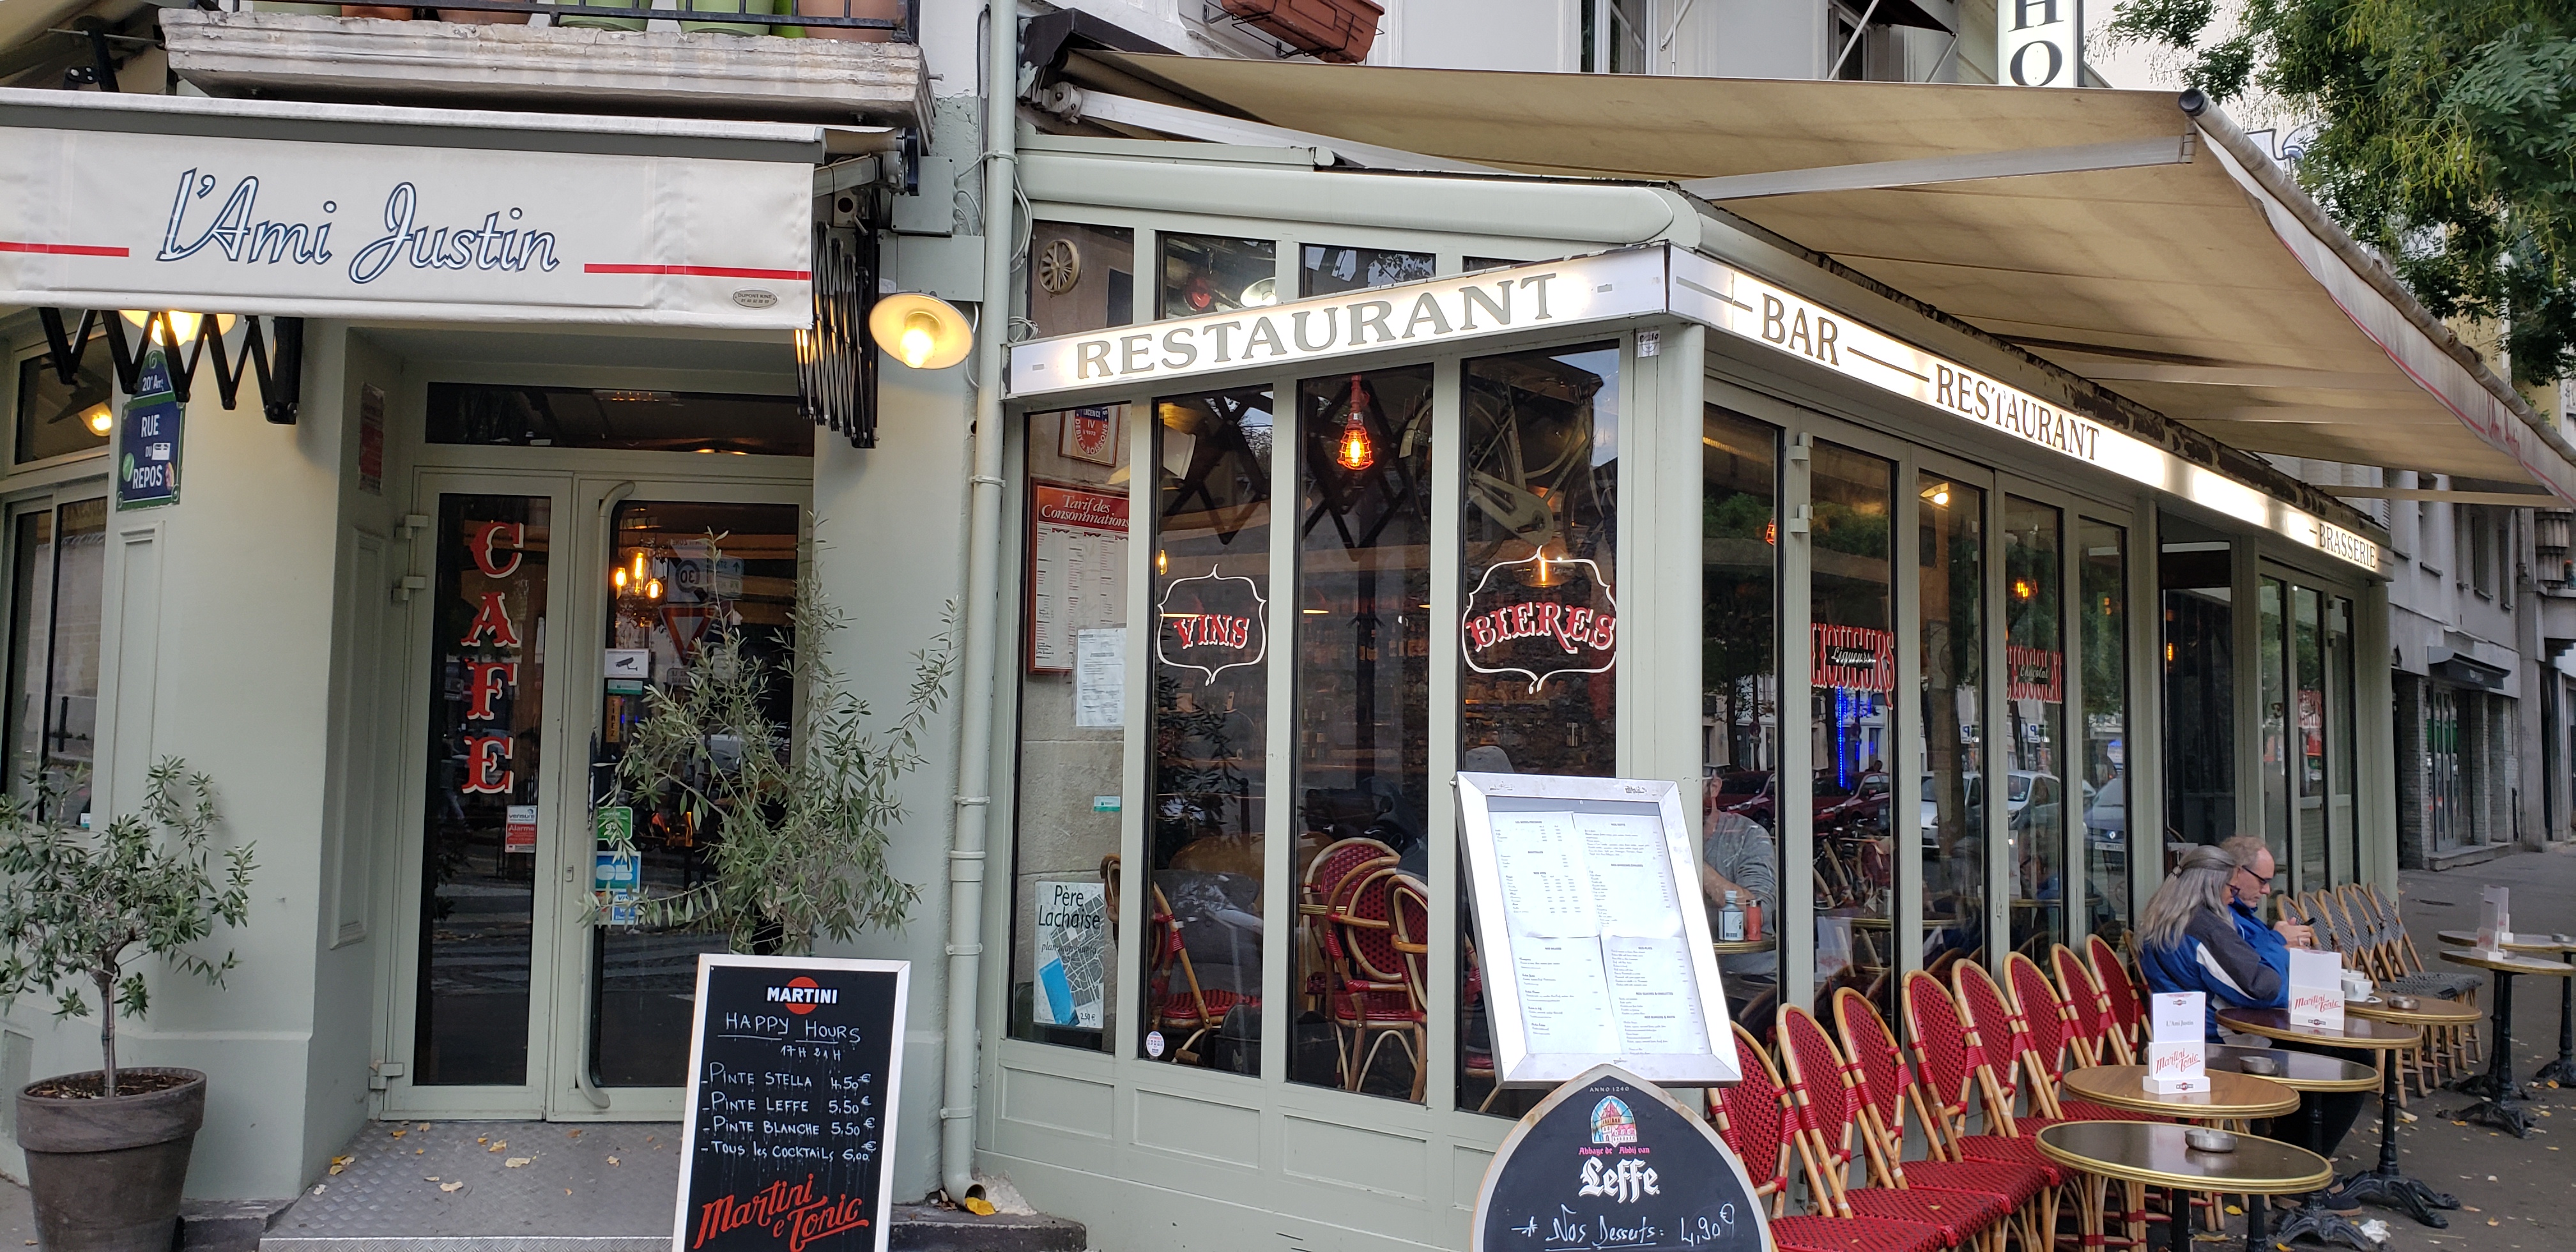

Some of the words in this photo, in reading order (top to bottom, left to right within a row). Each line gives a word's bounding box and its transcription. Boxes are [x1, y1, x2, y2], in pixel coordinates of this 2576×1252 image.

[156, 167, 337, 265] L'Ami
[348, 181, 560, 285] Justin
[1077, 273, 1557, 379] RESTAURANT
[1761, 292, 1840, 367] BAR
[1936, 363, 2100, 461] RESTAURANT
[1083, 408, 1101, 418] LICENCE
[1087, 419, 1096, 429] IV
[141, 414, 160, 438] RUE
[1075, 418, 1084, 441] DEBIT
[1086, 424, 1108, 454] BOISSONS
[132, 464, 162, 490] REPOS
[1041, 504, 1129, 528] Consommations
[1062, 494, 1096, 513] Tarif
[1093, 499, 1111, 514] des
[2319, 523, 2377, 570] BRASSERIE
[1172, 614, 1250, 650] VINS
[1465, 602, 1616, 654] BIERES
[460, 521, 525, 794] CAFE
[1831, 646, 1871, 667] Liqueurs
[2020, 665, 2048, 679] Chocolat
[1054, 885, 1084, 907] Père
[1038, 905, 1100, 929] Lachaise
[767, 986, 838, 1004] MARTINI
[2294, 993, 2326, 1010] Martini
[726, 1012, 789, 1035] HAPPY
[805, 1019, 861, 1043] HOURS
[2155, 1048, 2185, 1074] Martini
[2179, 1053, 2201, 1073] Tonic
[765, 1071, 813, 1087] STELLA
[765, 1096, 809, 1114] LEFFE
[763, 1120, 820, 1136] BLANCHE
[1578, 1146, 1604, 1156] Abbaye
[1604, 1146, 1613, 1155] de
[1618, 1146, 1637, 1156] Abdij
[1578, 1156, 1659, 1203] Leffe
[693, 1173, 815, 1249] Martini
[772, 1219, 785, 1238] e
[787, 1193, 870, 1252] Tonic
[1545, 1204, 1588, 1243] Nos
